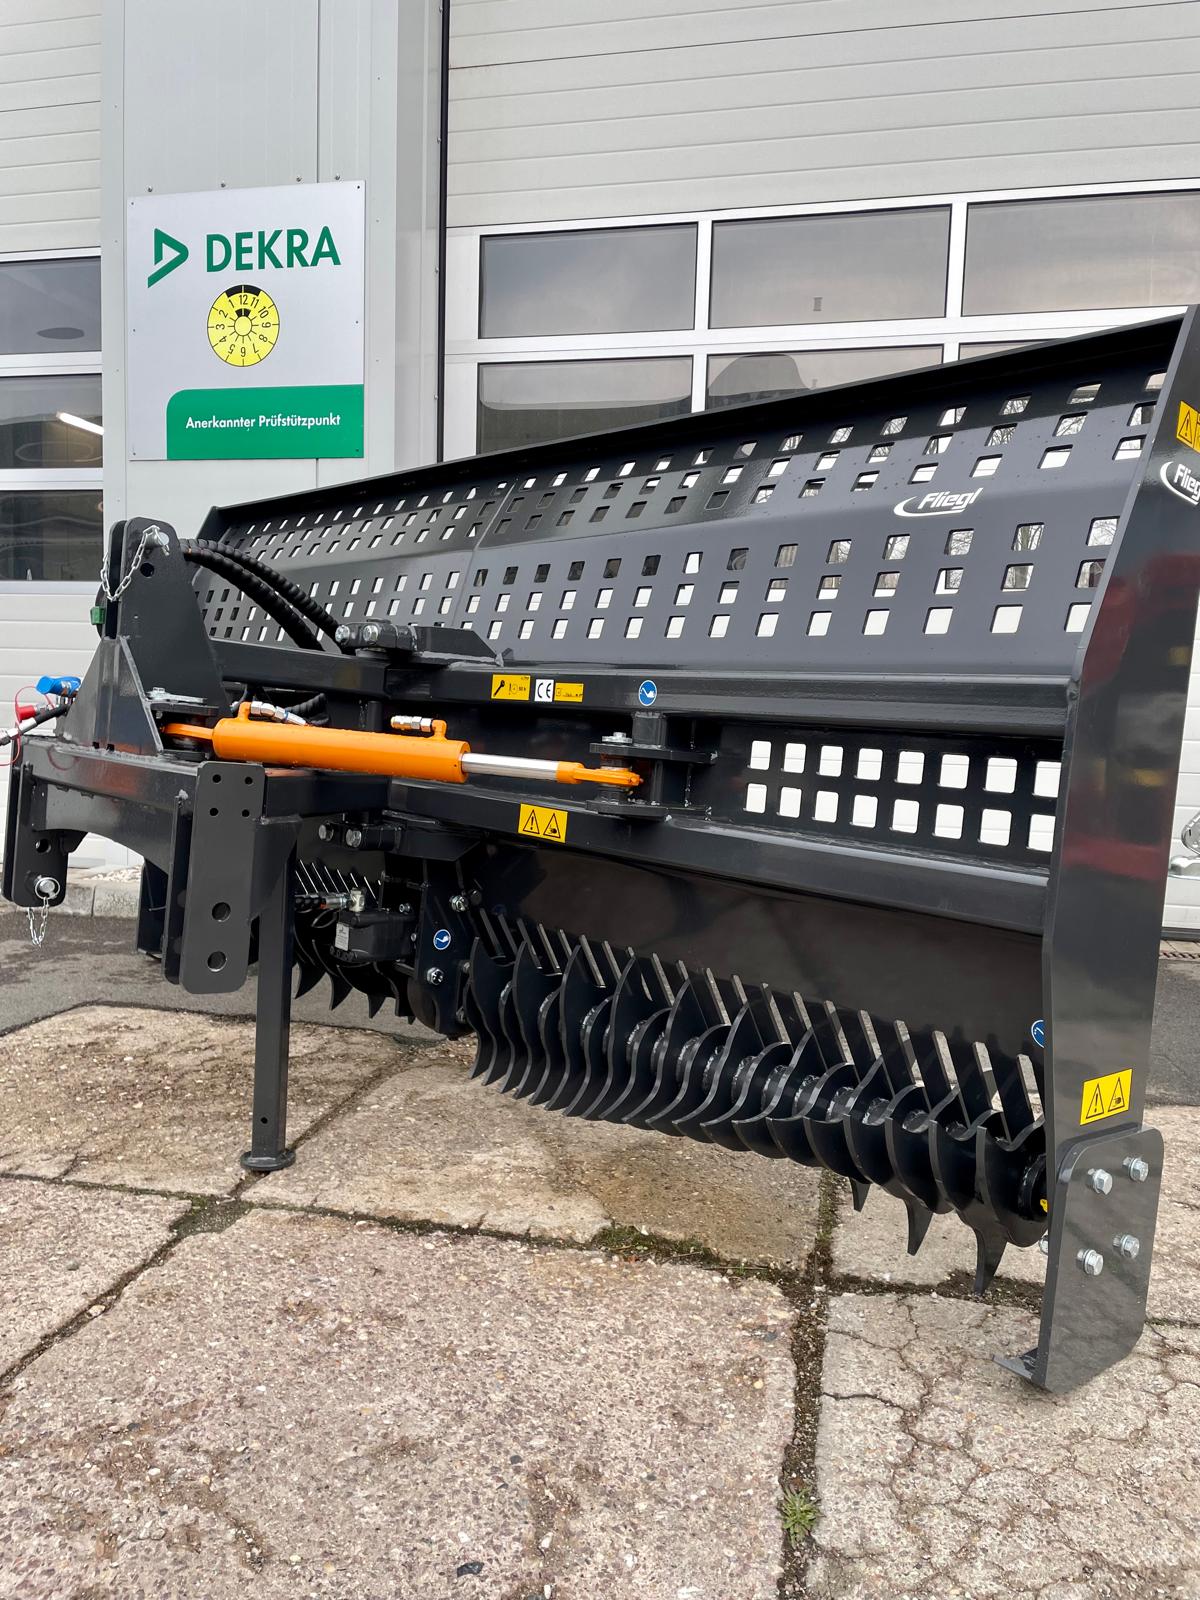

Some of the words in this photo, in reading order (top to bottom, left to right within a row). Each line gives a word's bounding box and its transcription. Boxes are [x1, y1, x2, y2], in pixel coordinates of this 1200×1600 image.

[206, 226, 342, 272] DEKRA
[229, 299, 235, 308] 1
[239, 294, 248, 305] 12
[250, 297, 260, 308] 11
[218, 309, 228, 318] 2
[258, 306, 269, 318] 10
[259, 334, 268, 343] 8
[228, 344, 235, 354] 5
[252, 343, 259, 353] 7
[185, 415, 256, 429] Anerkannter
[258, 412, 341, 430] Prüfstützpunkt
[917, 487, 984, 510] Fliegl
[537, 682, 552, 699] CE
